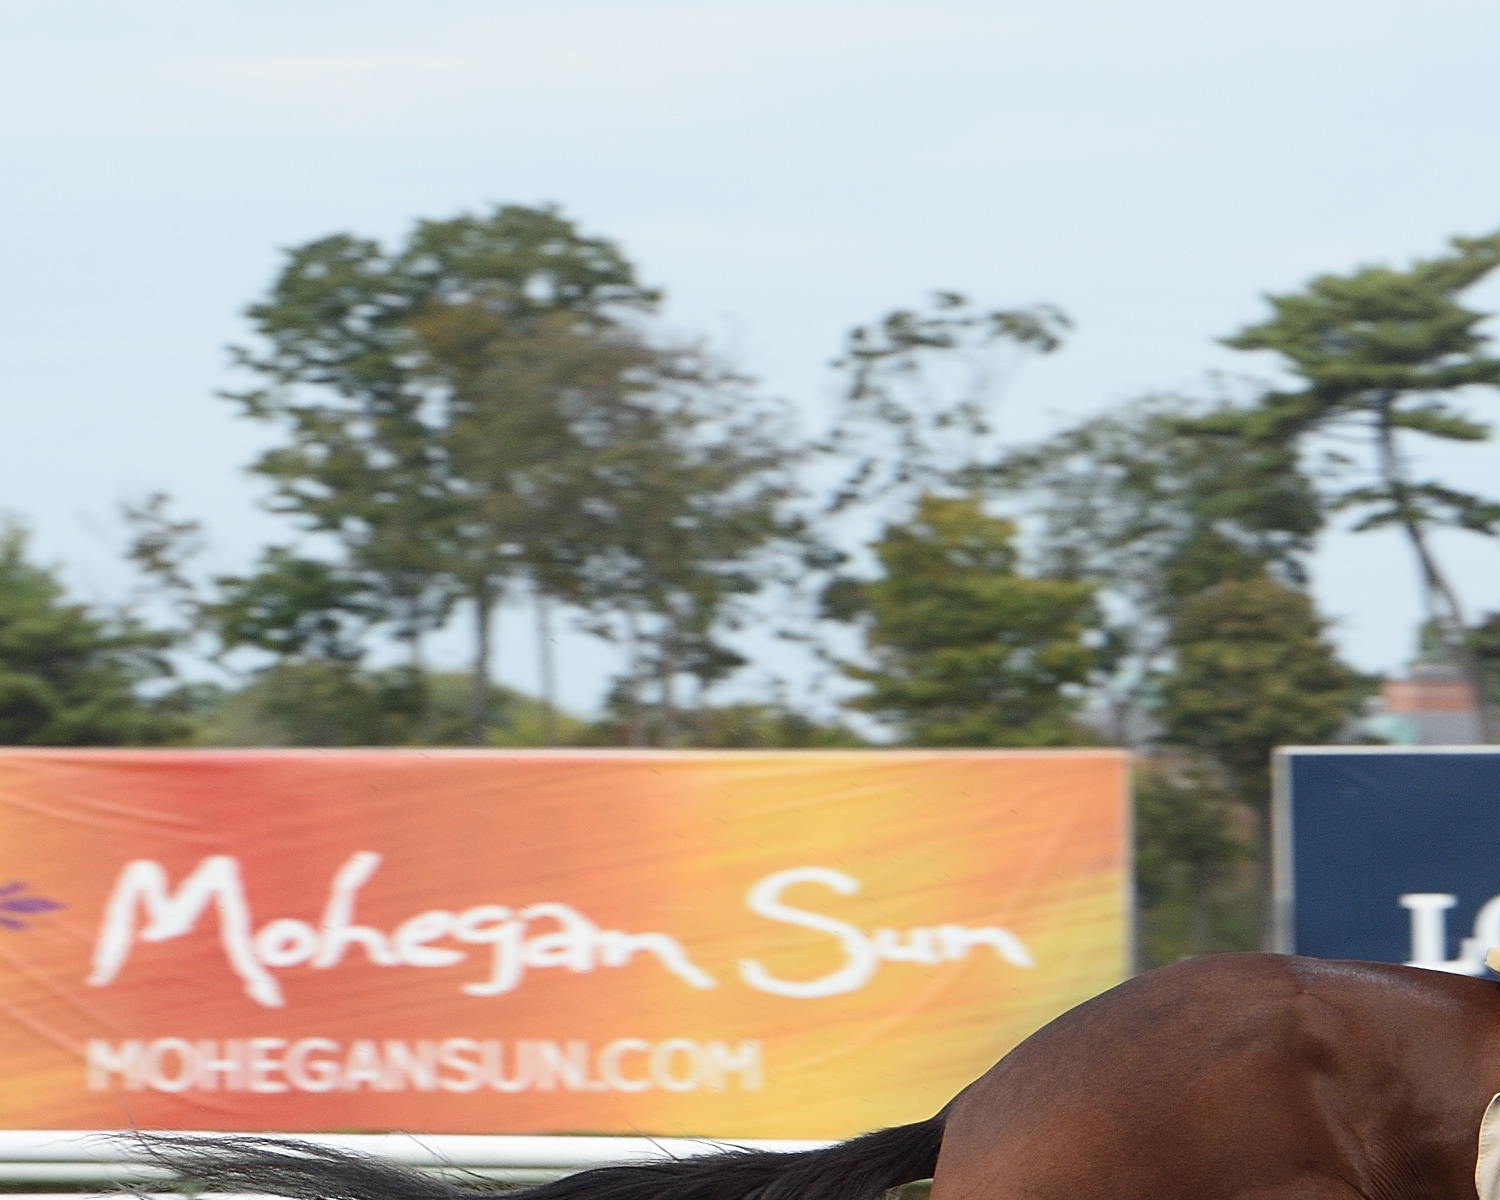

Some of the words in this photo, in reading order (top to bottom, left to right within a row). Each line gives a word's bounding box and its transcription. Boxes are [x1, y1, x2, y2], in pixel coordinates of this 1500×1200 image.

[88, 850, 716, 1008] Mohegan
[742, 867, 1034, 998] Sun
[86, 1036, 762, 1092] MOHEGANSUN.COM
